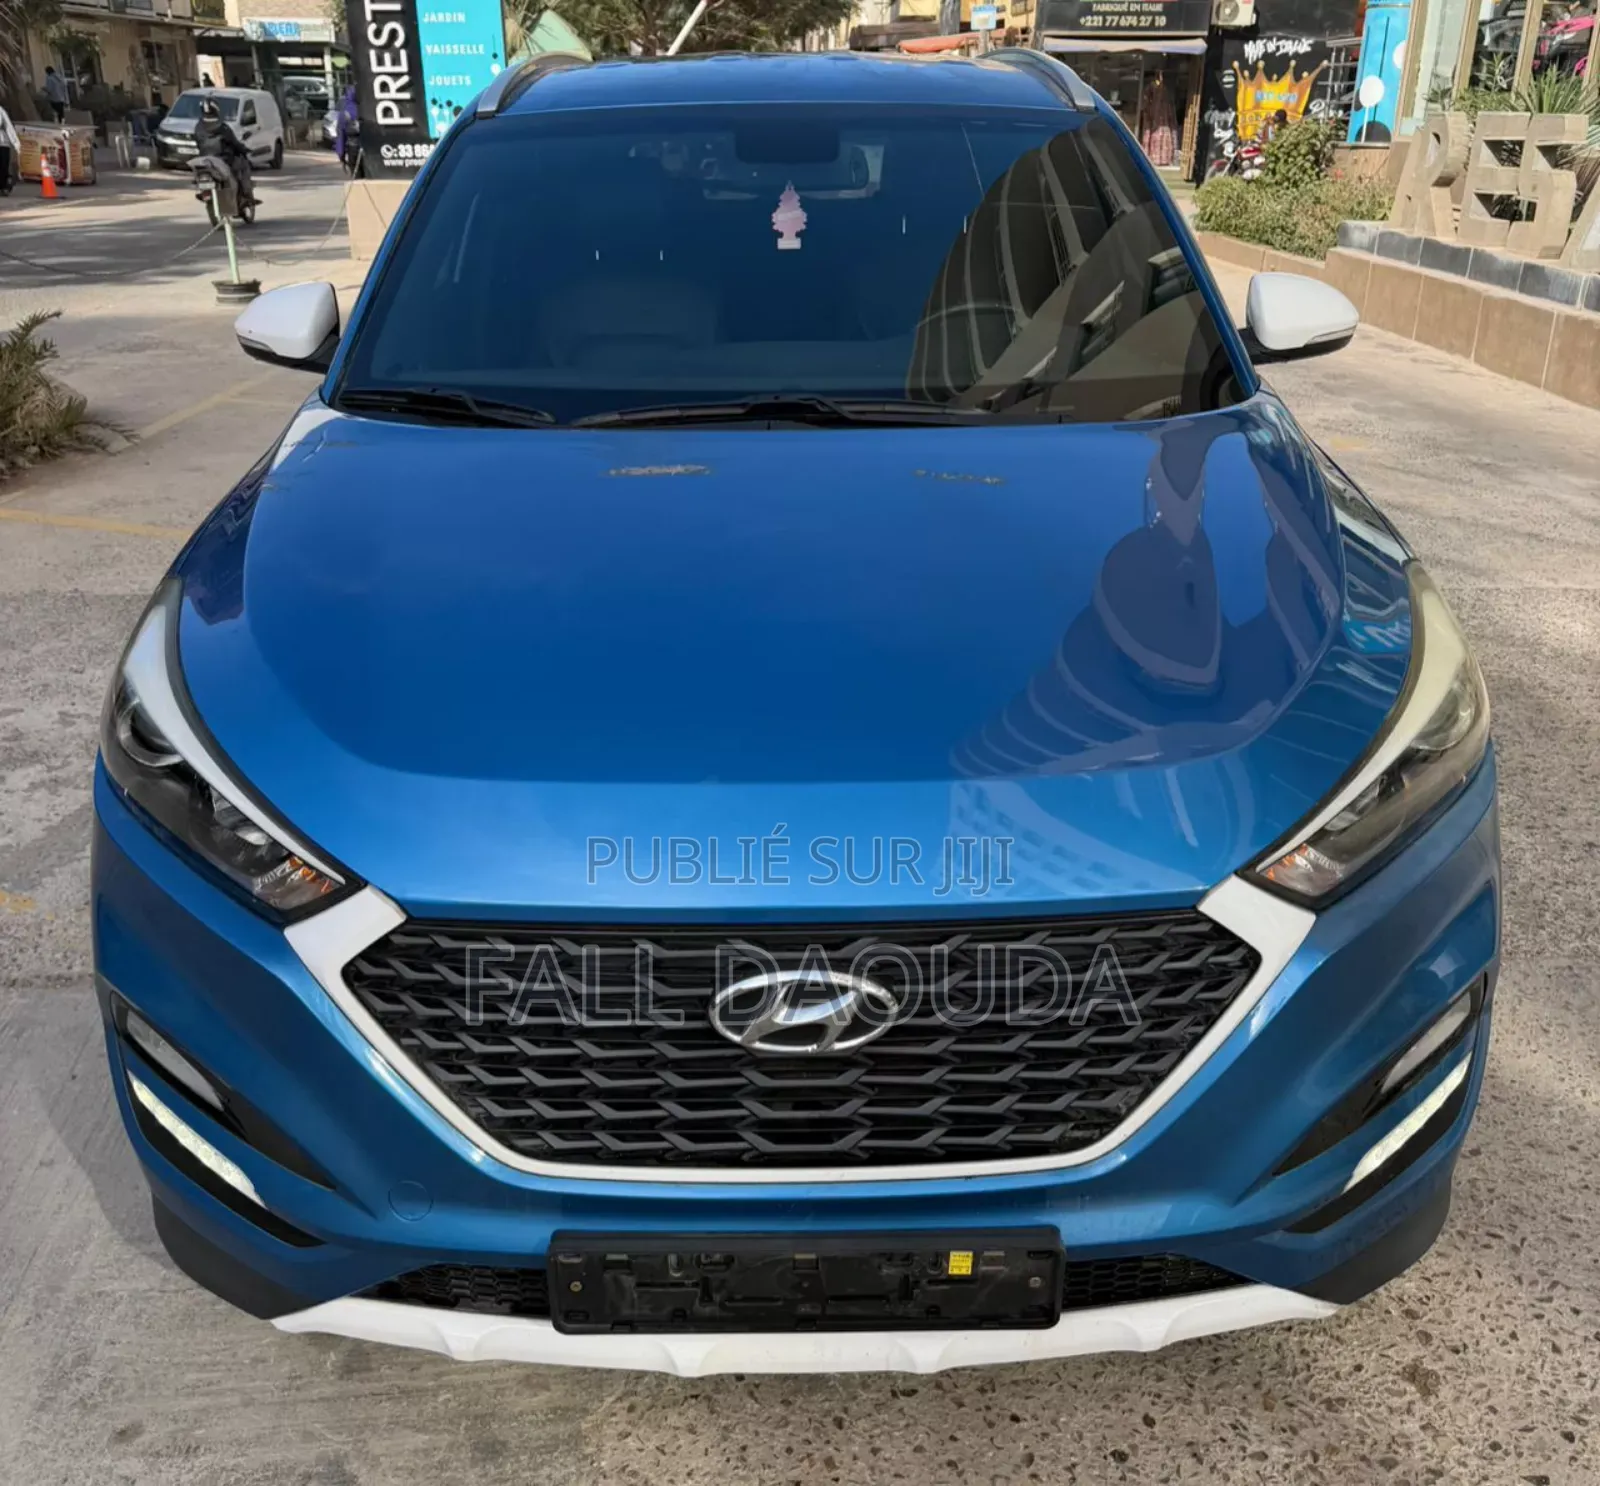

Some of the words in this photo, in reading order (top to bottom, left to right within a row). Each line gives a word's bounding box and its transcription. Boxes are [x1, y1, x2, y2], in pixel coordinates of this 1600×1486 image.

[1129, 3, 1141, 12] EN
[423, 12, 466, 23] JARDIN
[1080, 15, 1104, 27] +221
[1104, 15, 1119, 27] 77
[1138, 15, 1153, 27] 27
[424, 43, 485, 55] VAISSELLE
[429, 75, 472, 86] JOUETS
